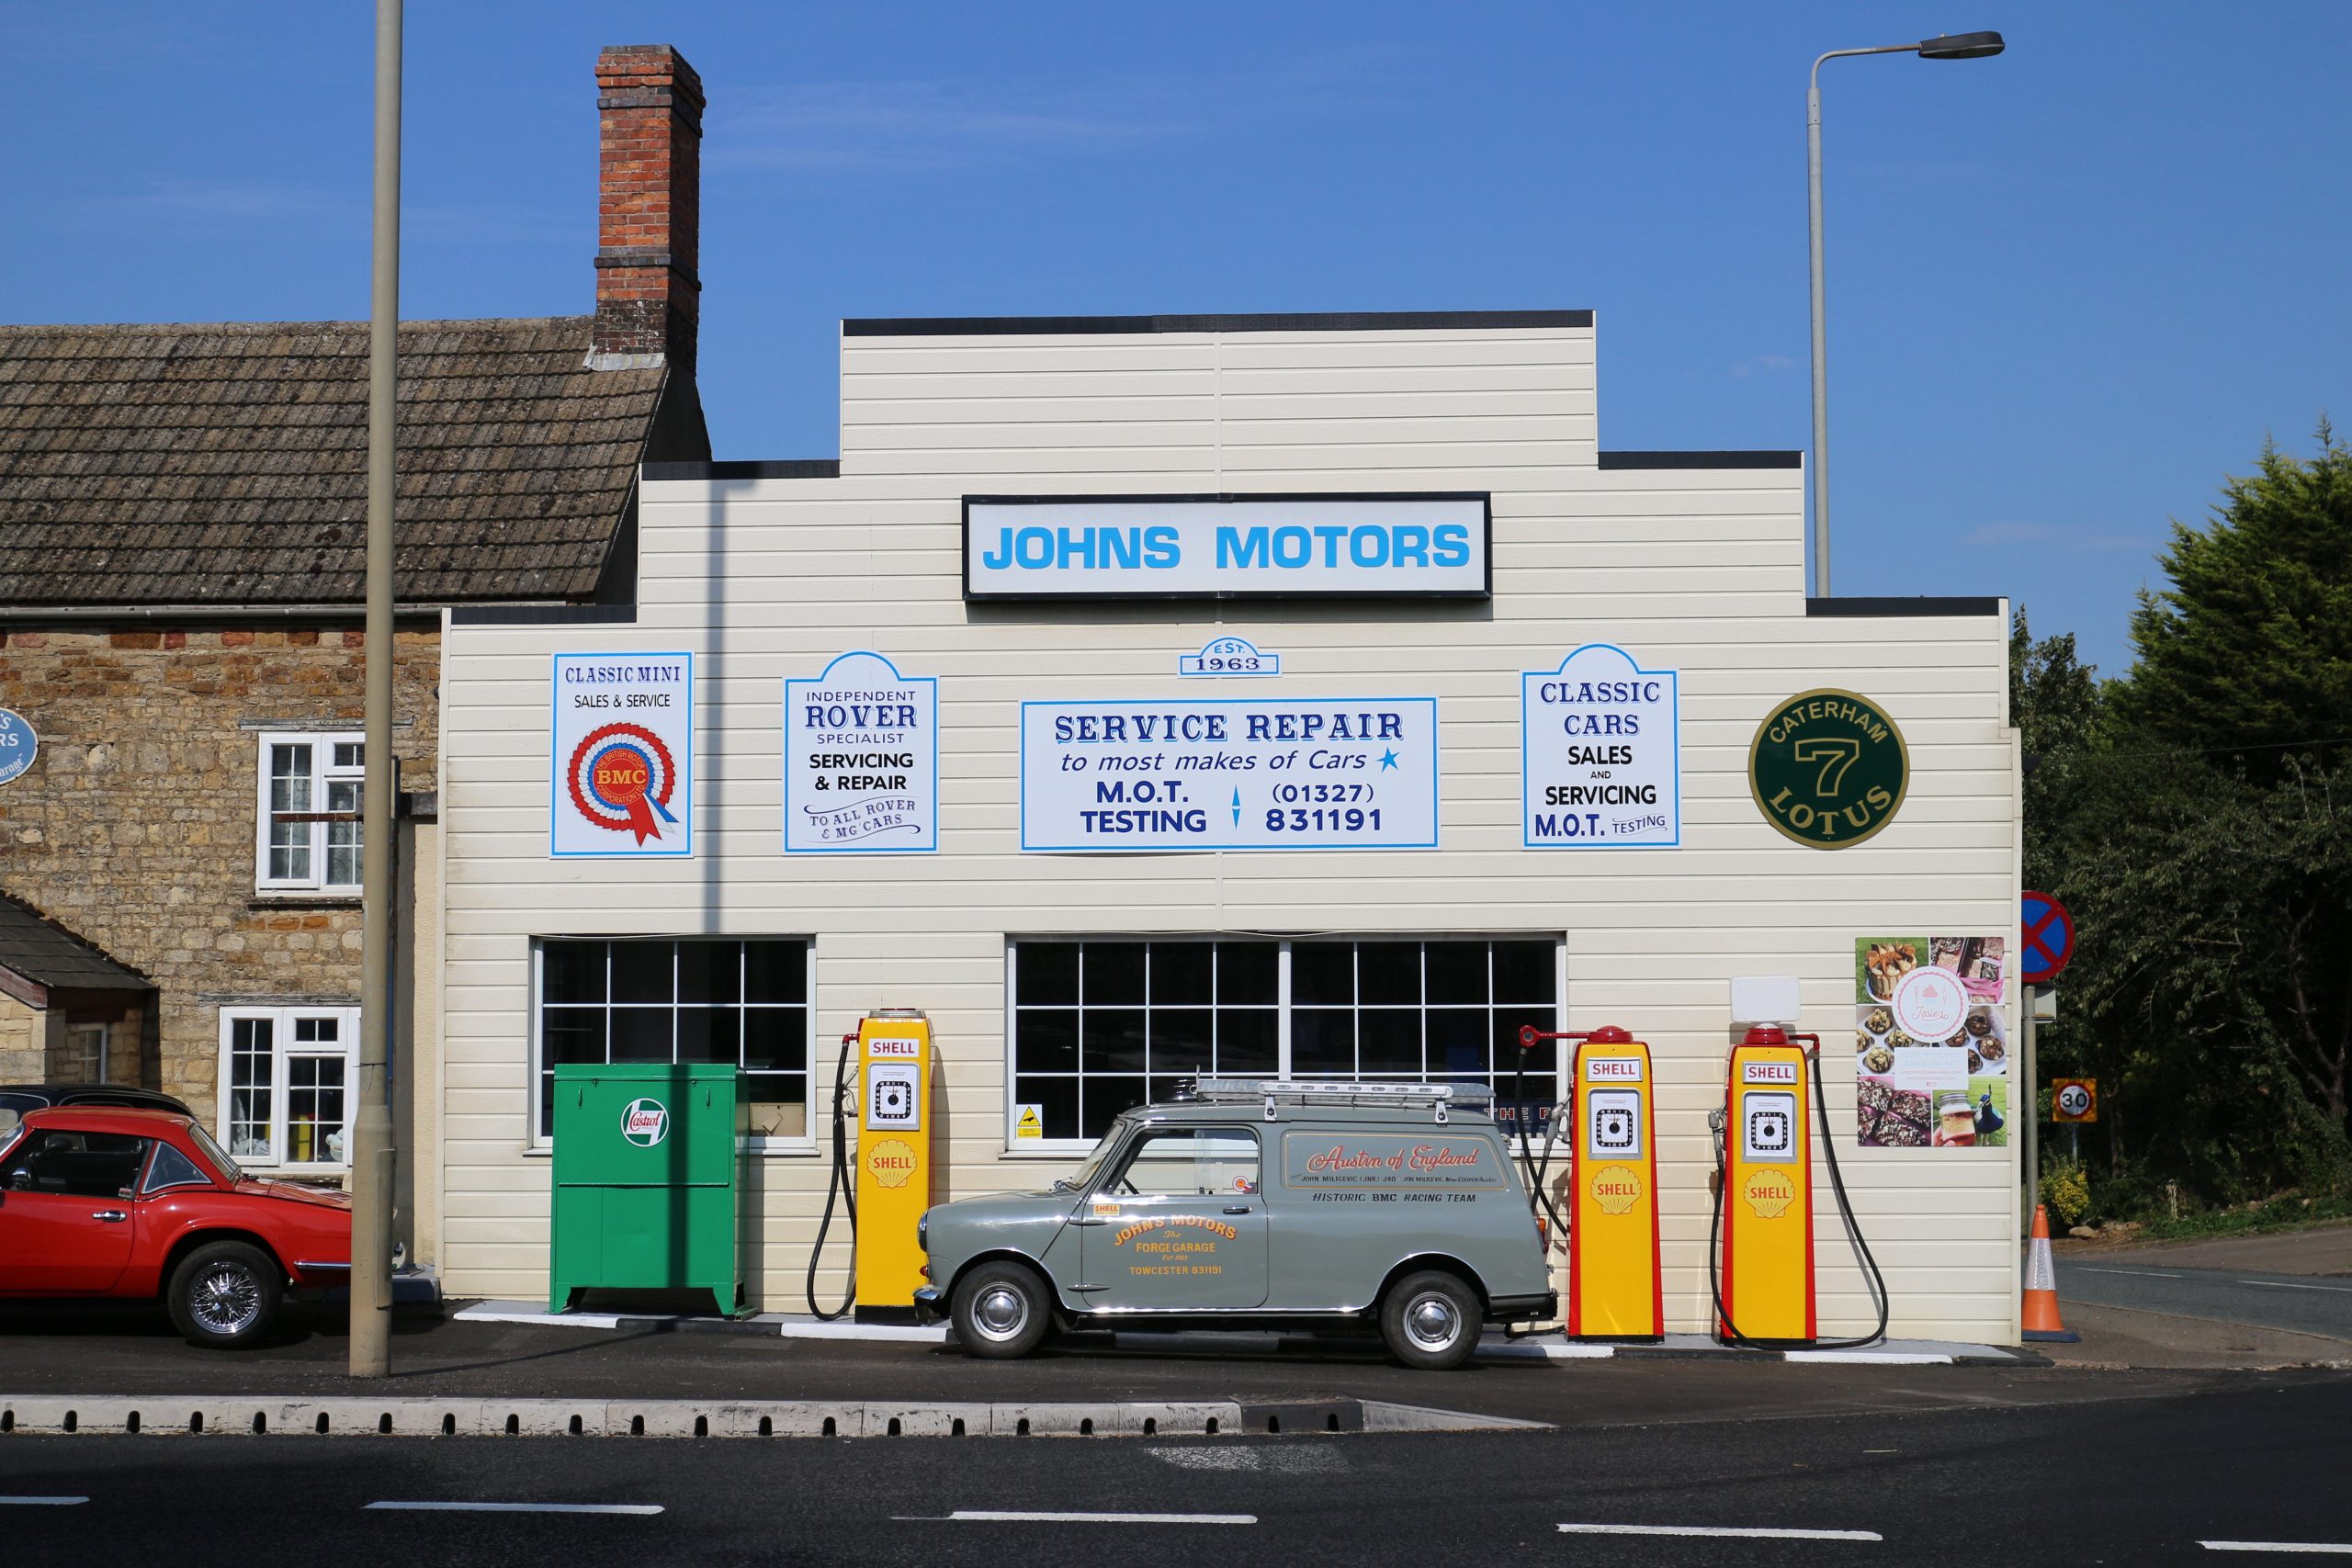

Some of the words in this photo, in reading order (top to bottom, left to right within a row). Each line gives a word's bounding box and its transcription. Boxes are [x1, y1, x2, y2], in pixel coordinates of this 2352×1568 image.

[982, 526, 1182, 570] JOHNS
[1216, 524, 1471, 569] MOTORS
[1214, 643, 1246, 653] EST.
[565, 667, 634, 683] CLASSIC
[638, 666, 681, 682] MINI
[1196, 658, 1261, 671] 1963
[574, 694, 609, 707] SALES
[613, 694, 622, 707] &
[627, 694, 671, 707] SERVICE
[807, 691, 916, 702] INDEPENDENT
[1540, 682, 1660, 705] CLASSIC
[805, 705, 918, 729] ROVER
[1564, 714, 1640, 737] CARS
[1770, 701, 1888, 743] CATERHAM
[817, 733, 905, 744] SPECIALIST
[1054, 714, 1227, 745] SERVICE
[1247, 712, 1404, 742] REPAIR
[596, 758, 607, 770] THE
[605, 750, 627, 761] BRITISH
[628, 751, 645, 769] MOTOR
[809, 753, 913, 769] SERVICING
[1061, 753, 1088, 772] to
[1098, 752, 1164, 772] most
[1175, 750, 1256, 772] makes
[1269, 750, 1298, 771] of
[1308, 750, 1367, 771] Cars
[1567, 745, 1633, 765] SALES
[597, 770, 646, 784] BMC
[1794, 738, 1860, 796] 7
[815, 775, 830, 790] &
[838, 775, 907, 790] REPAIR
[1096, 781, 1189, 804] M.O.T.
[1272, 783, 1374, 803] (01327)
[597, 784, 636, 804] CORPORATION
[1545, 785, 1657, 806] SERVICING
[809, 816, 828, 826] TO
[833, 810, 861, 825] ALL
[865, 799, 916, 815] ROVER
[1769, 785, 1892, 835] LOTUS
[821, 829, 830, 839] &
[836, 826, 857, 839] MG
[864, 814, 902, 831] CARS
[1080, 810, 1206, 833] TESTING
[1266, 808, 1381, 831] 831191
[1535, 813, 1605, 837] M.O.T.
[1612, 816, 1666, 833] TESTING
[873, 1042, 914, 1054] SHELL
[1592, 1064, 1635, 1075] SHELL
[1748, 1066, 1792, 1078] SHELL
[2062, 1093, 2087, 1108] 30
[629, 1111, 662, 1132] Castrol
[874, 1157, 911, 1168] SHELL
[1306, 1145, 1383, 1172] Austin
[1385, 1149, 1405, 1171] of
[1408, 1145, 1479, 1172] England
[1312, 1193, 1366, 1202] HISTORIC
[1373, 1193, 1396, 1202] BMC
[1404, 1193, 1443, 1202] RACING
[1448, 1194, 1476, 1202] TEAM
[1598, 1183, 1635, 1195] SHELL
[1750, 1187, 1789, 1199] SHELL
[1163, 1230, 1182, 1238] The
[1170, 1214, 1238, 1240] MOTORS
[1136, 1243, 1170, 1253] FORGE
[1172, 1243, 1216, 1253] GARAGE
[1129, 1267, 1188, 1275] TOWCESTER
[1191, 1266, 1222, 1275] 831191
